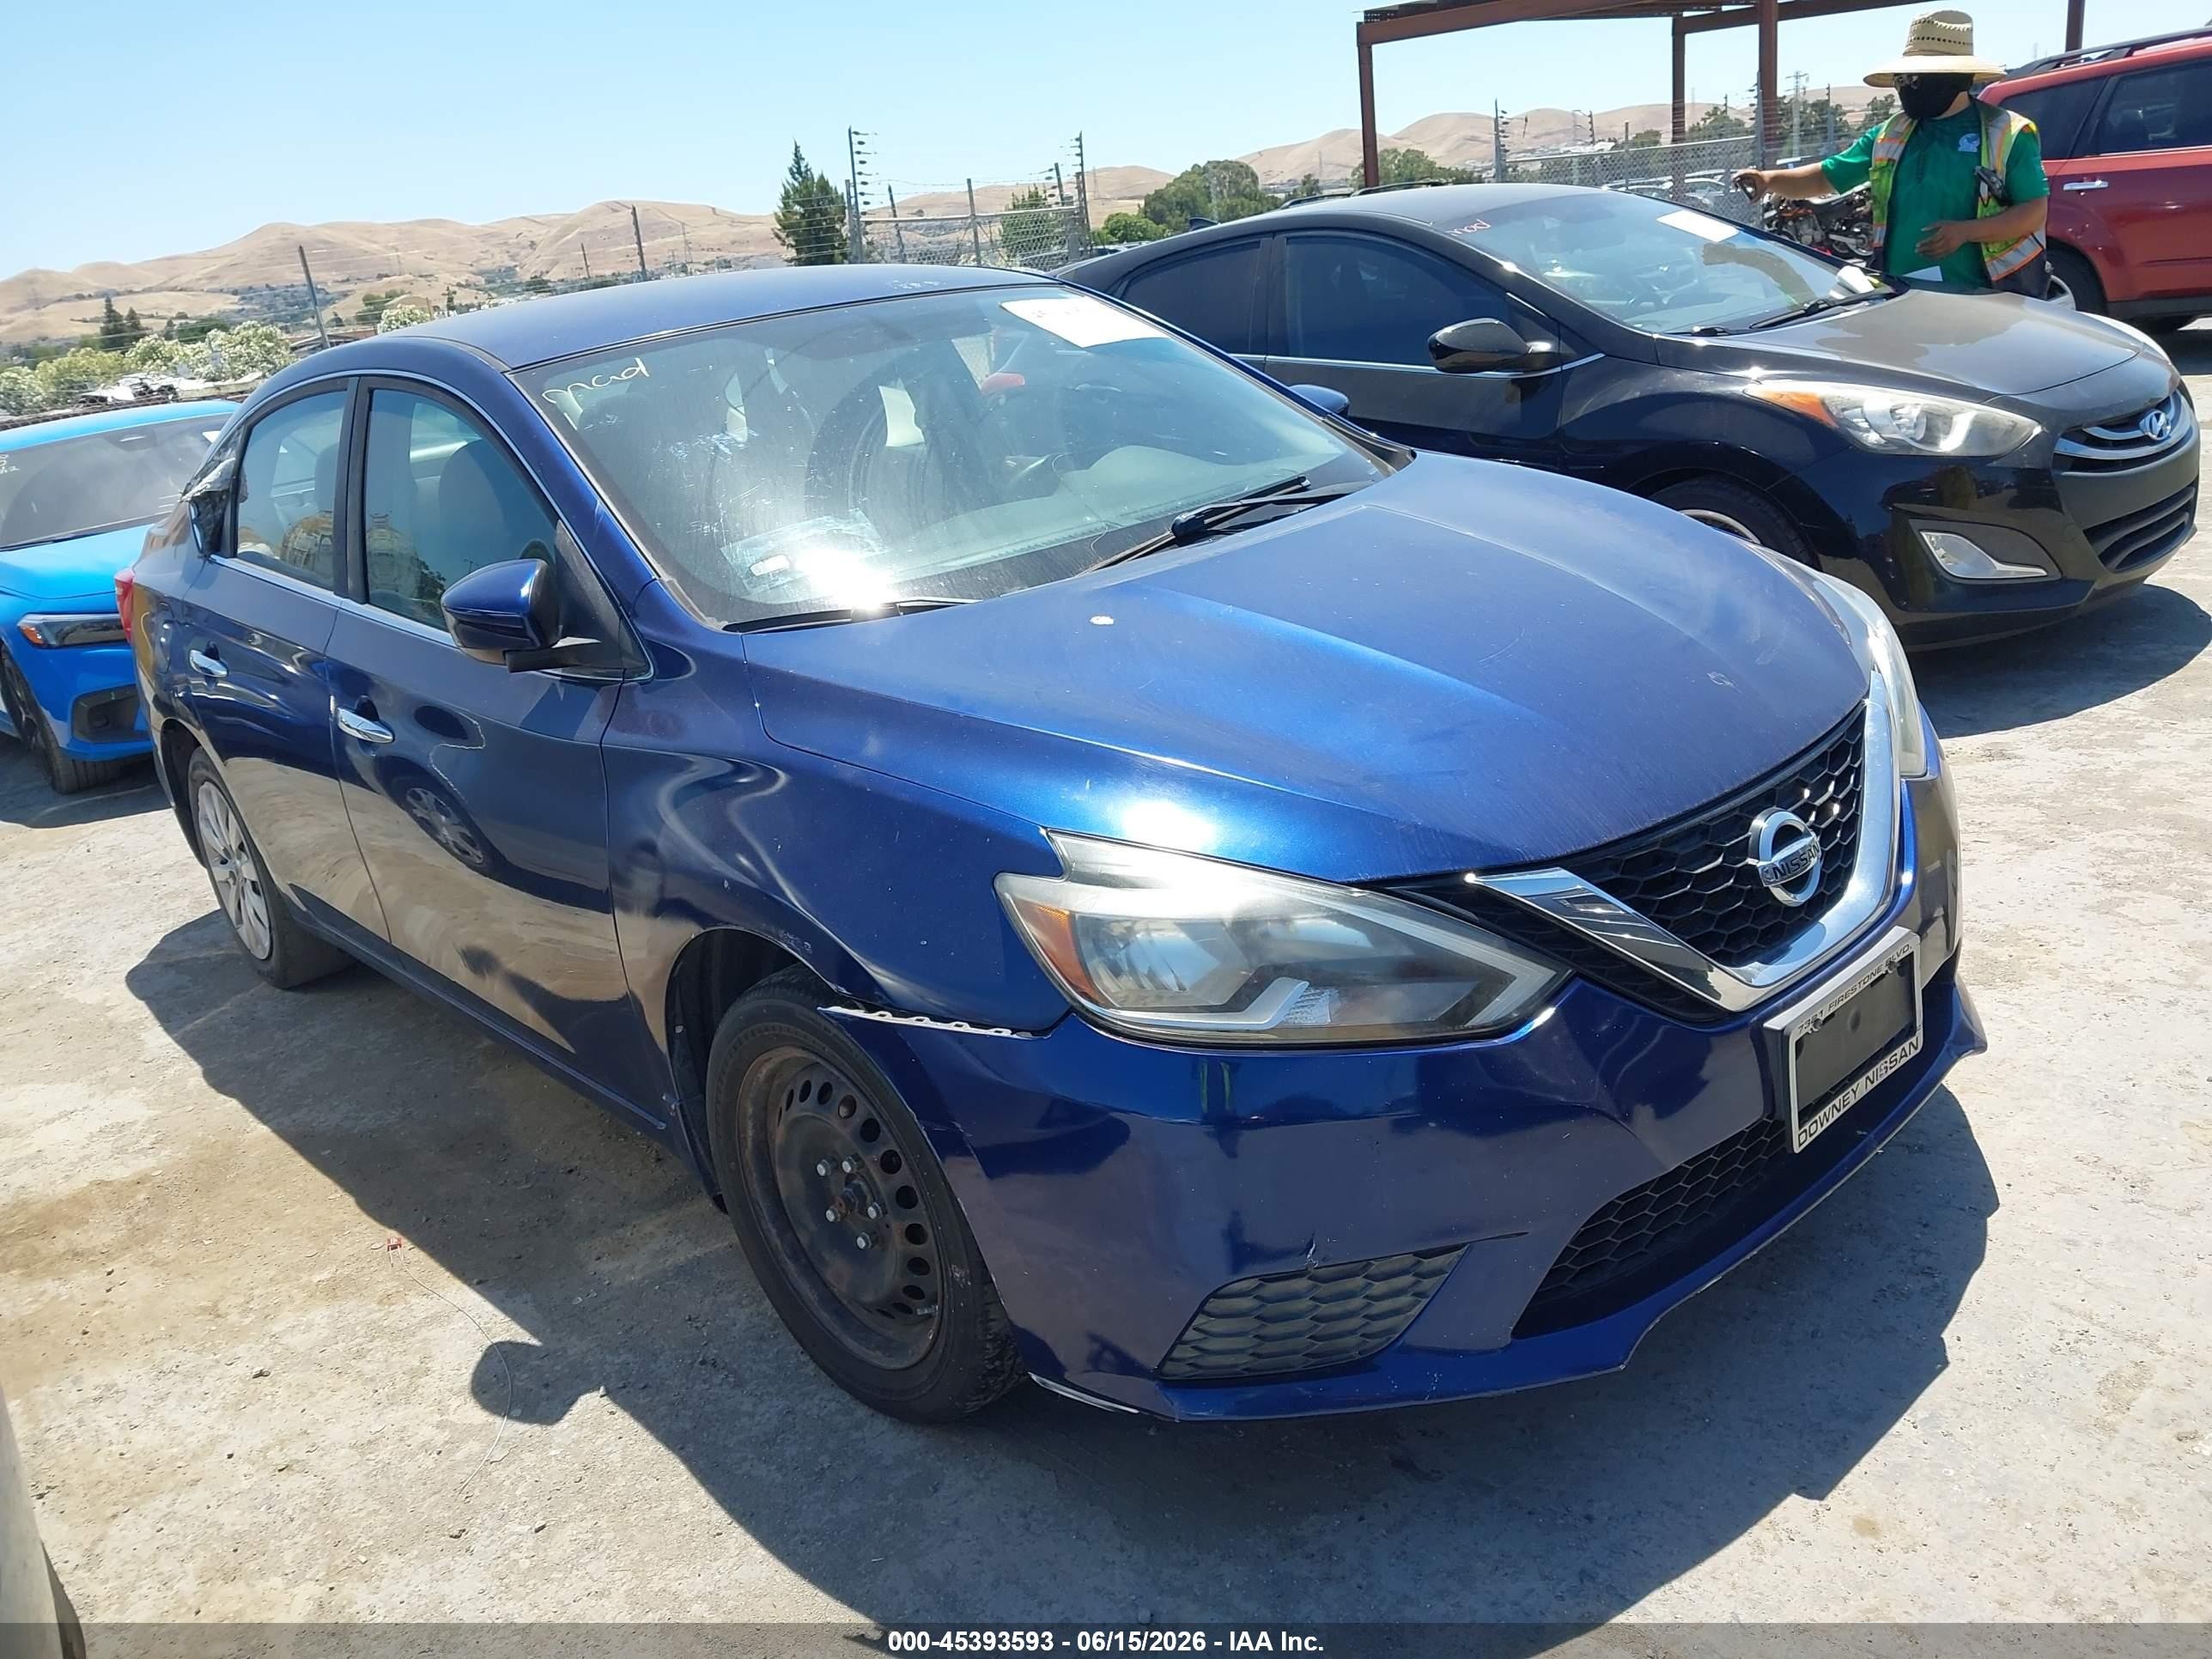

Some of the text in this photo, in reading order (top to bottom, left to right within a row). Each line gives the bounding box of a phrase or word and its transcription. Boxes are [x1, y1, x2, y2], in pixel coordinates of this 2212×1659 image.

[1772, 839, 1820, 880] NISSAN
[1827, 963, 1883, 1012] FIRESTONE
[1797, 1036, 1920, 1148] DOWNEY NISSAN
